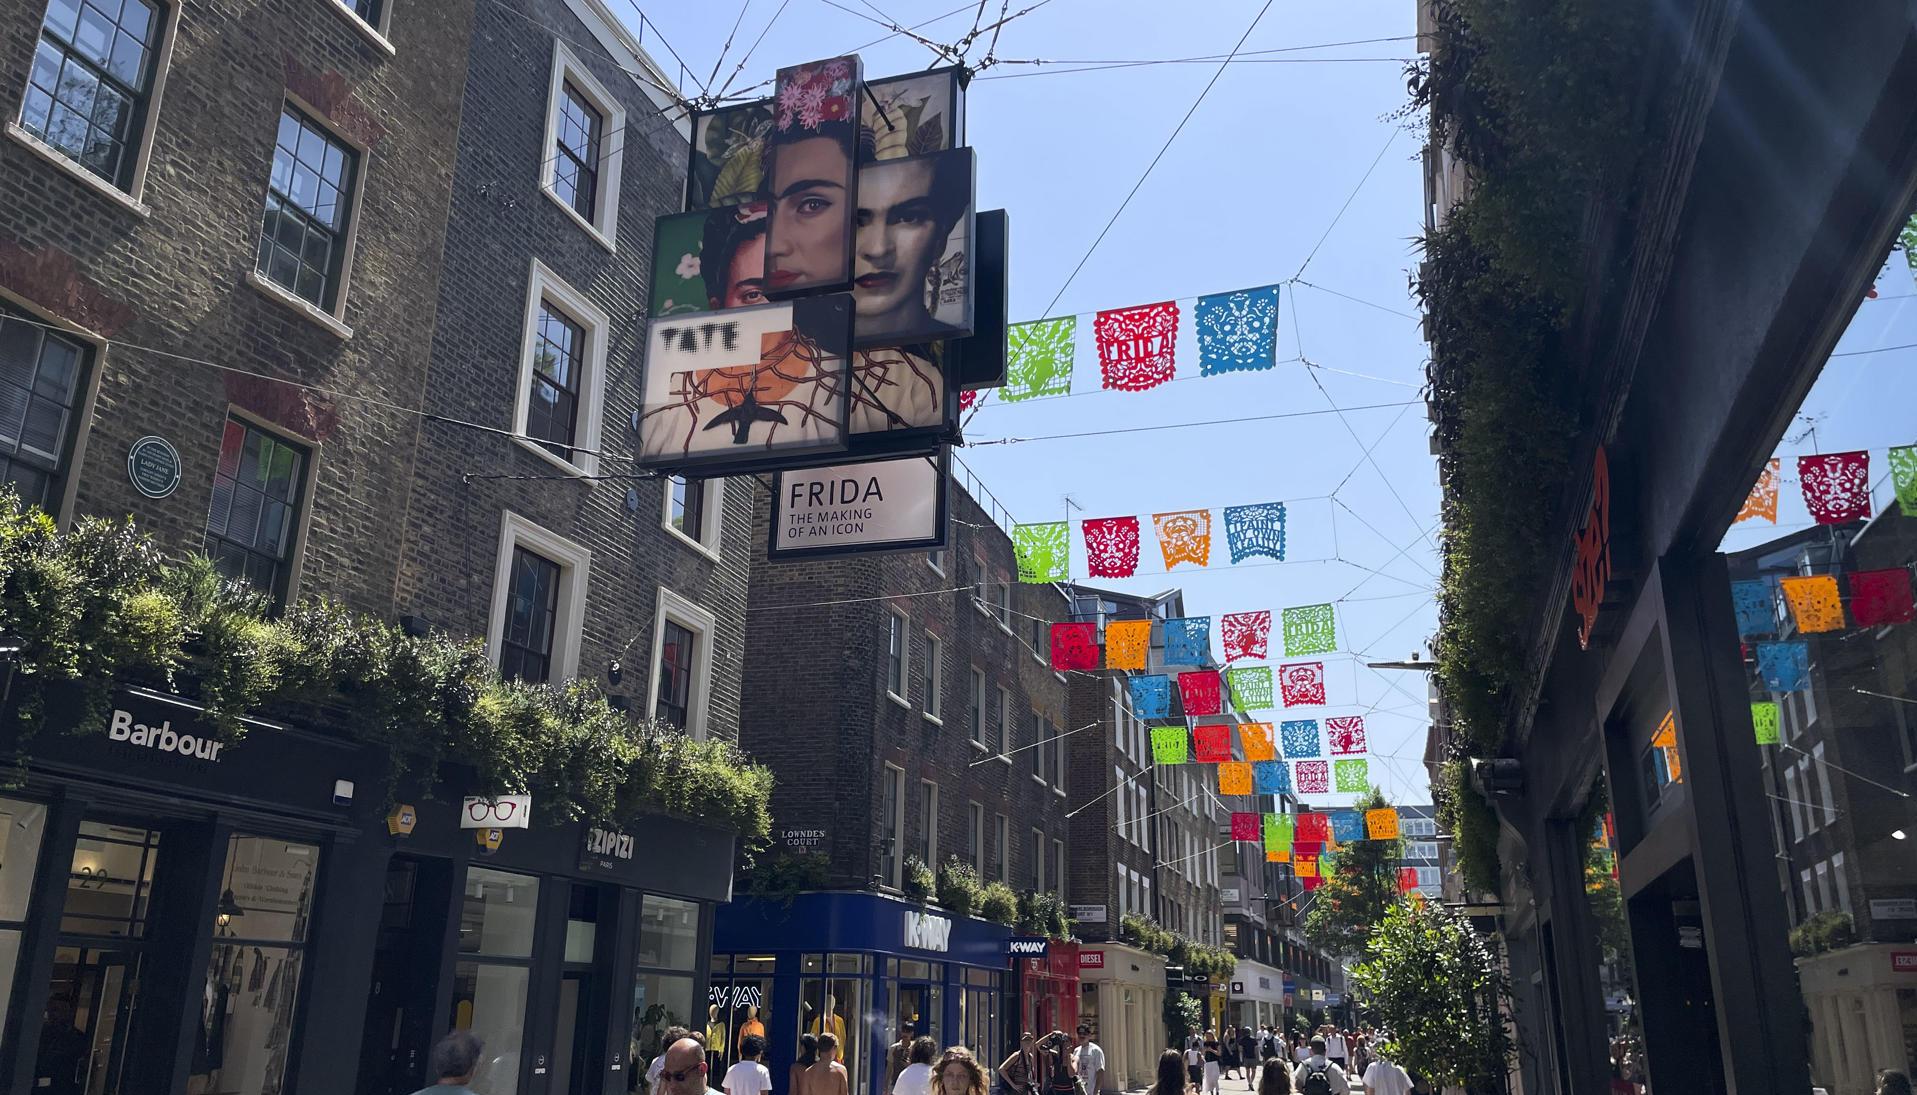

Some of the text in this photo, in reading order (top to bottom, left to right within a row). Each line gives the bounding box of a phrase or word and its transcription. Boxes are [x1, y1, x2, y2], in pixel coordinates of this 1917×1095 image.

[660, 322, 739, 353] TATE
[1105, 333, 1171, 361] FRIDA
[141, 458, 155, 469] LADY
[790, 476, 883, 509] FRIDA
[789, 508, 872, 525] THE MAKING
[1241, 519, 1277, 531] PAINT
[788, 522, 864, 539] OF AN ICON
[1252, 528, 1281, 541] OWN
[1288, 620, 1331, 637] FRIDA
[109, 709, 224, 762] Barbour
[781, 830, 825, 839] LOWNDES
[787, 838, 819, 846] COURT
[80, 866, 108, 890] 29
[1080, 954, 1102, 964] DIESEL
